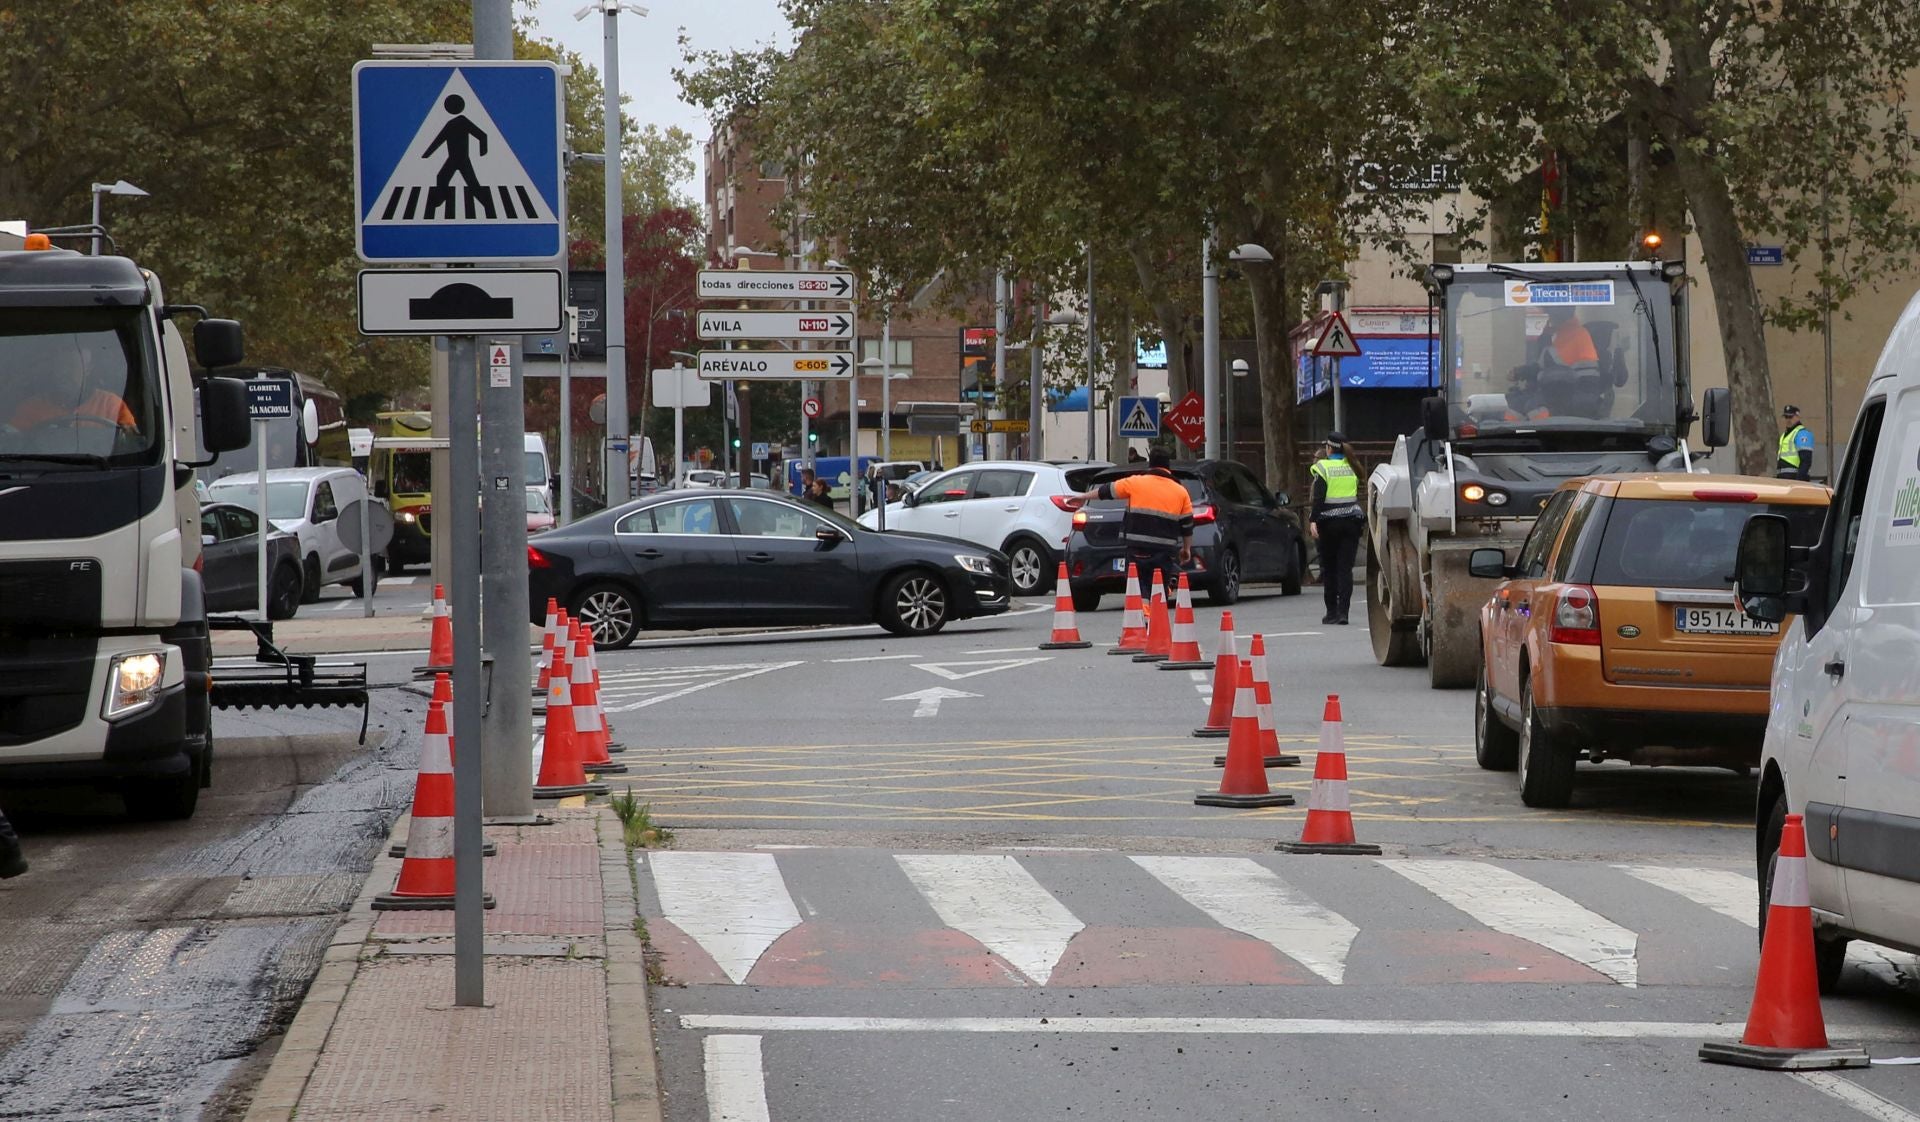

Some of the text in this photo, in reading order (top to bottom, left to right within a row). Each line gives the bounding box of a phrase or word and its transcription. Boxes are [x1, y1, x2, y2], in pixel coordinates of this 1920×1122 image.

[702, 280, 828, 290] todas direcciones SG-20
[1536, 288, 1568, 298] Tecno
[702, 318, 827, 331] ÁVILA N-110
[702, 358, 828, 372] ARÉVALO C-605
[259, 405, 290, 414] NACIONAL
[70, 561, 91, 571] FE
[1690, 610, 1734, 628] 9514
